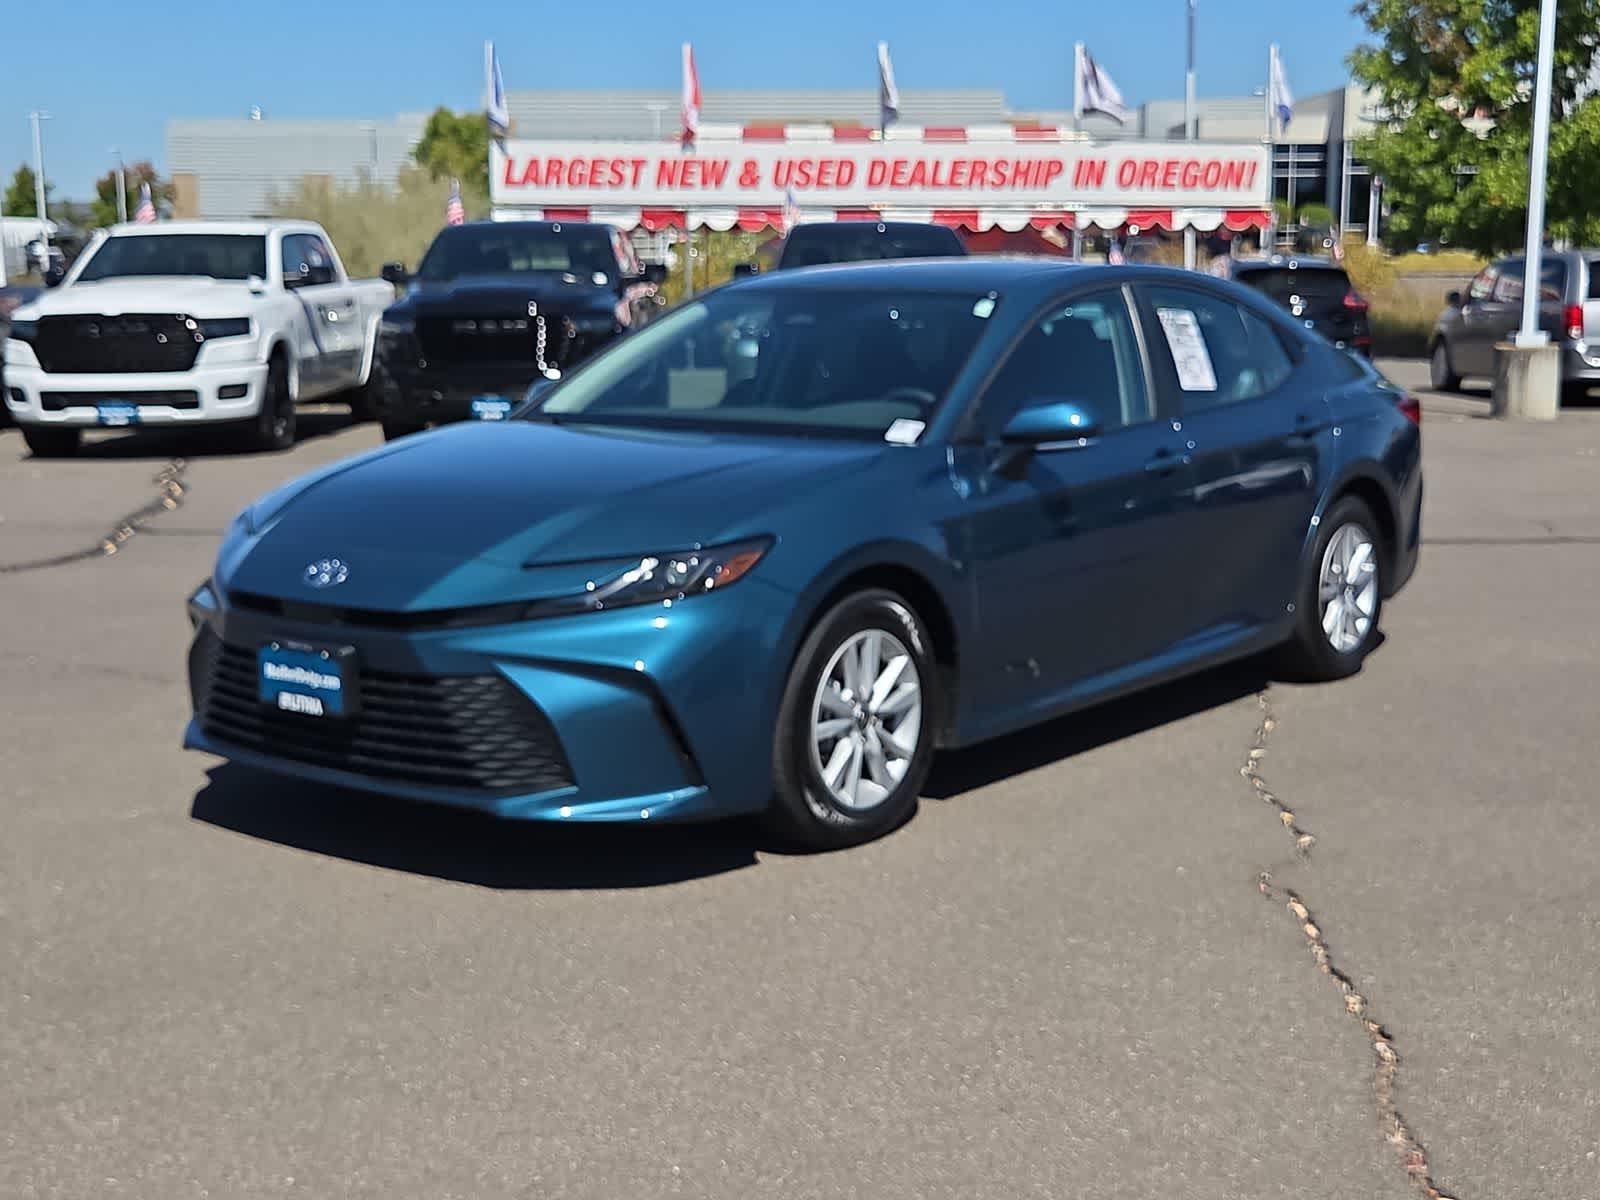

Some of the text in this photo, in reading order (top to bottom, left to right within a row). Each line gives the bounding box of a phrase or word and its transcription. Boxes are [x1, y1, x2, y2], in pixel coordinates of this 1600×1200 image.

[504, 157, 1257, 188] LARGEST NEW & USED DEALERSHIP IN OREGON!
